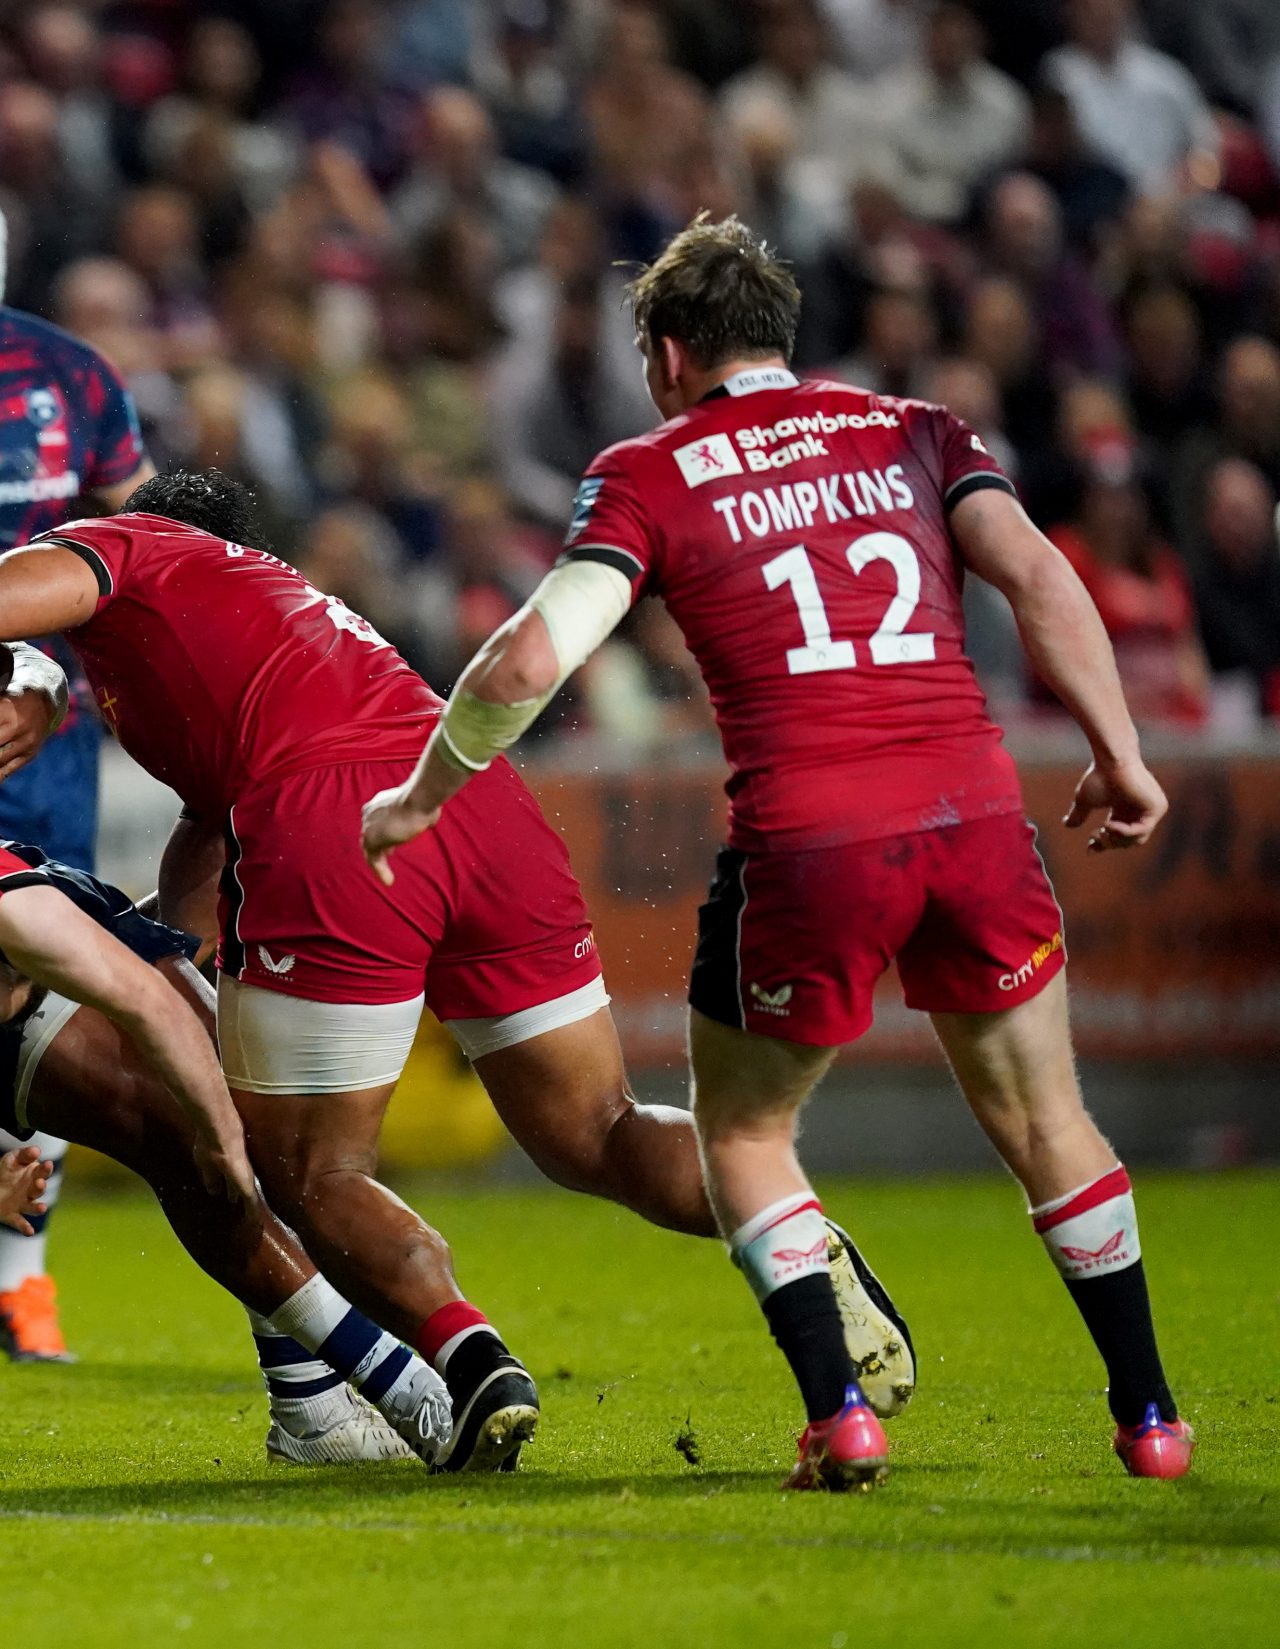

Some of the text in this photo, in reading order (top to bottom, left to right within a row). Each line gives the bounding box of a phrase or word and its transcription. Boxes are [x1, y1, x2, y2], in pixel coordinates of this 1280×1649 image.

[735, 411, 901, 449] Shawbrook
[744, 433, 830, 472] Bank
[713, 464, 914, 543] TOMPKINS
[761, 531, 936, 675] 12
[998, 958, 1034, 991] CITY
